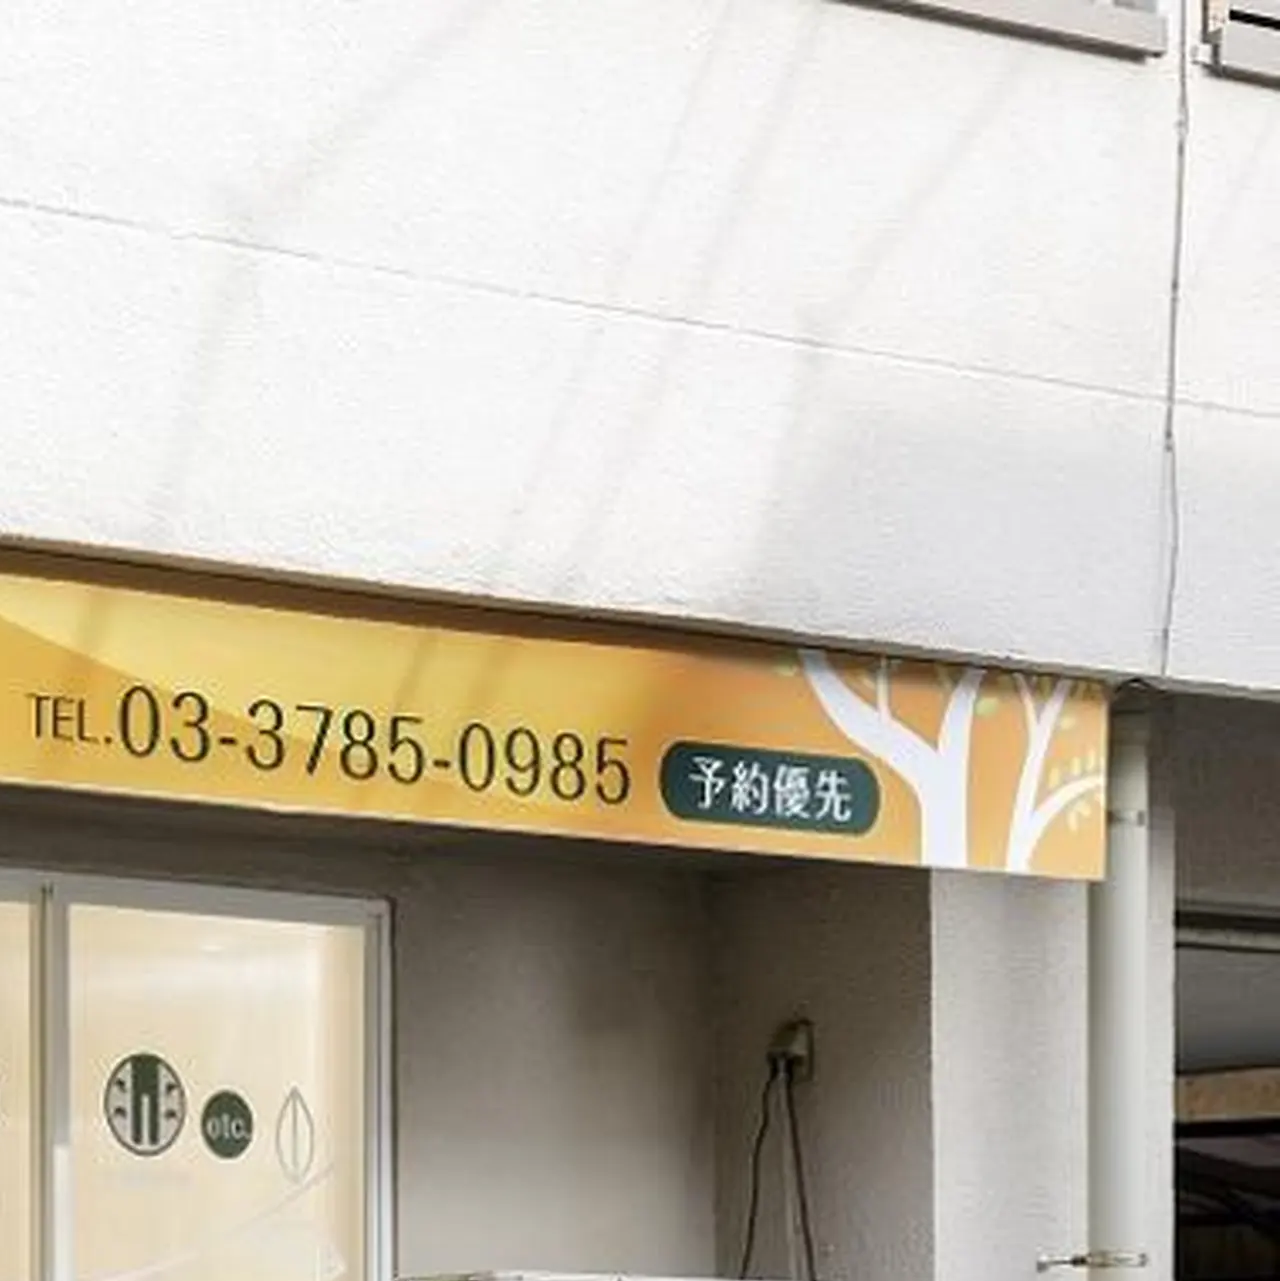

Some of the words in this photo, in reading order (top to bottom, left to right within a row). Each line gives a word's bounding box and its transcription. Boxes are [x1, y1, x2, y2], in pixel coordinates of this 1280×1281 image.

[116, 684, 634, 806] 03-3785-0985
[687, 756, 856, 826] 予約優先
